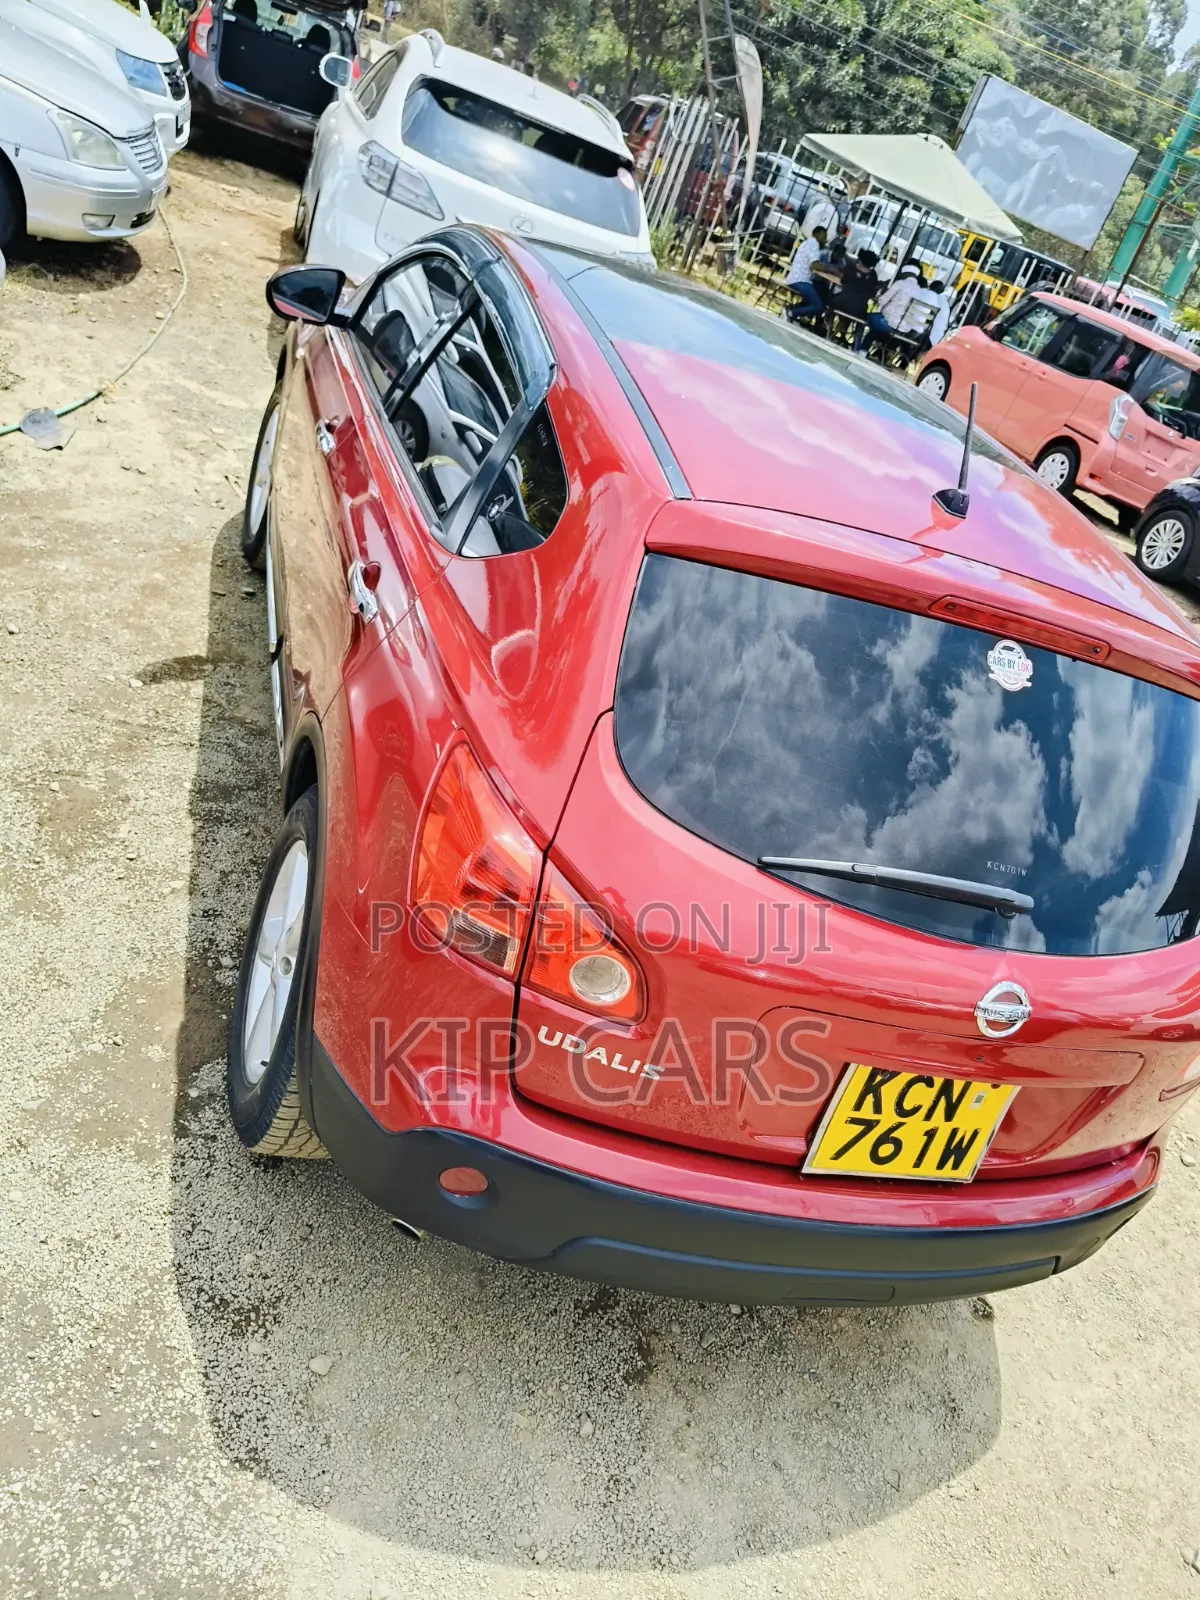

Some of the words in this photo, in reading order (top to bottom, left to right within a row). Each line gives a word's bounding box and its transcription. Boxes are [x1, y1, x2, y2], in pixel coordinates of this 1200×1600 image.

[1007, 659, 1016, 670] BY
[982, 1007, 1031, 1020] NISSAN
[537, 1024, 667, 1082] UDALIS
[851, 1066, 973, 1122] KCN
[829, 1117, 981, 1170] 761W
